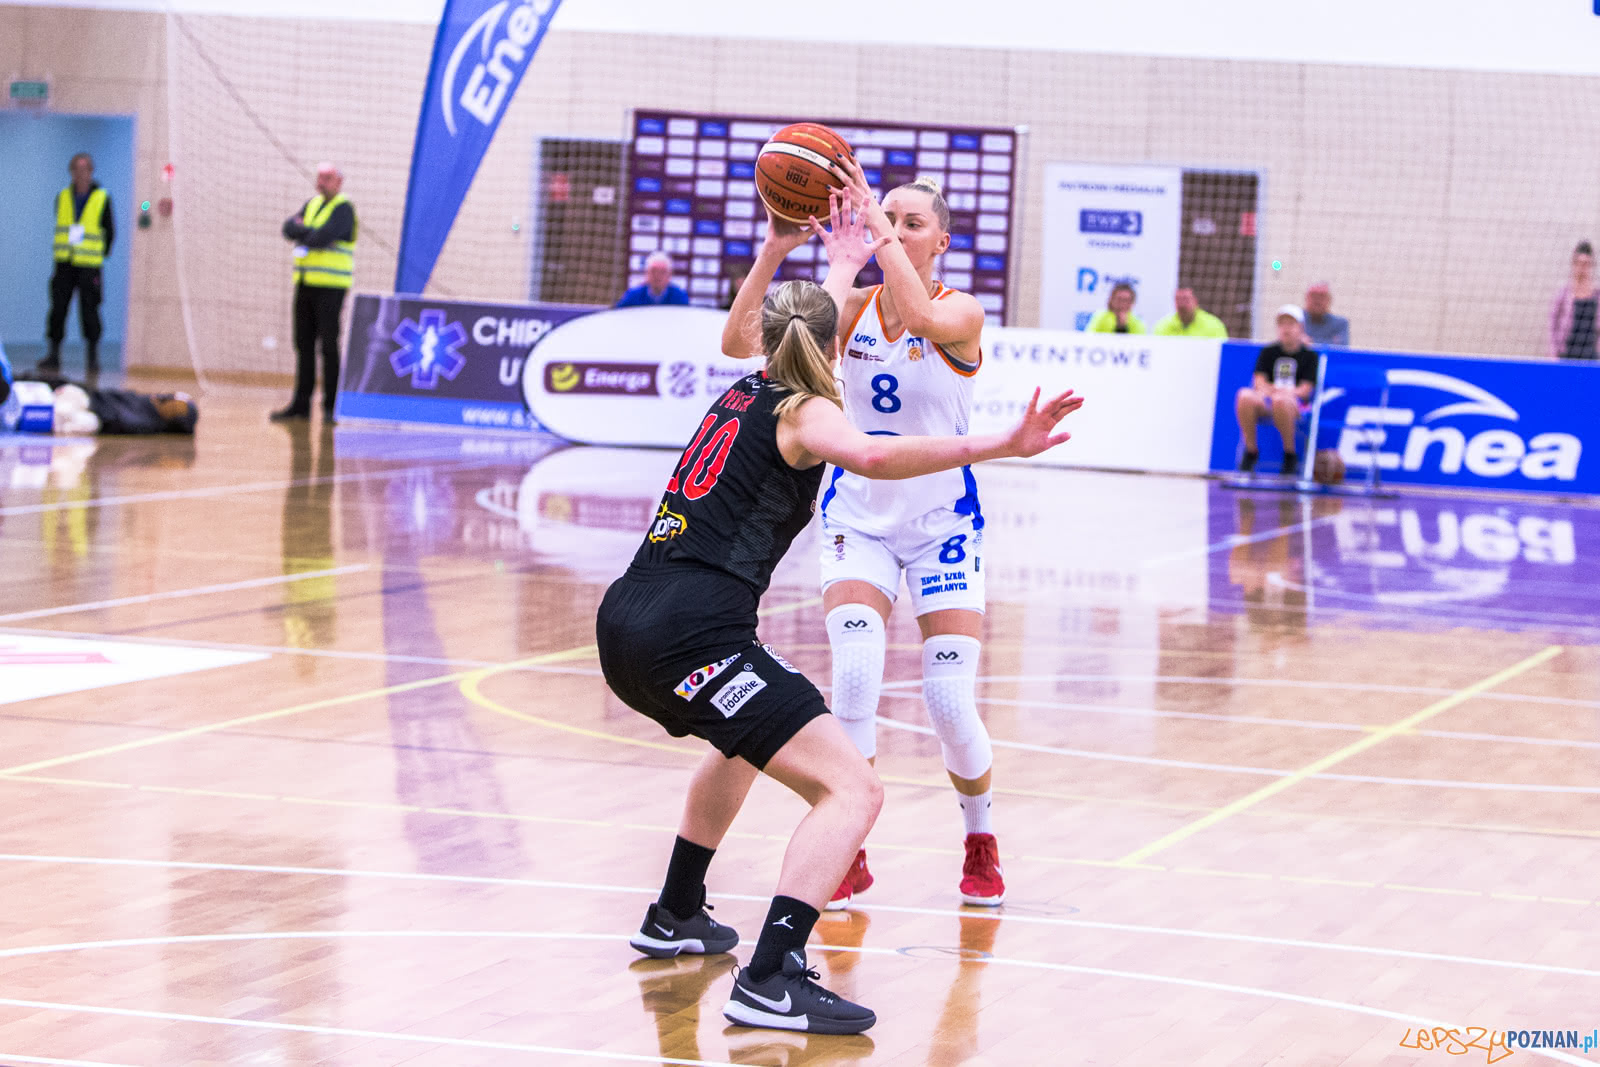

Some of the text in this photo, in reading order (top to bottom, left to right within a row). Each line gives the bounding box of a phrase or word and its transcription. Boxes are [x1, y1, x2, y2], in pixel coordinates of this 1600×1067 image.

[785, 170, 809, 188] FIBA
[764, 184, 819, 214] molten
[871, 373, 902, 414] 8
[666, 413, 740, 501] 10
[1337, 405, 1583, 481] Enea
[938, 534, 967, 564] 8
